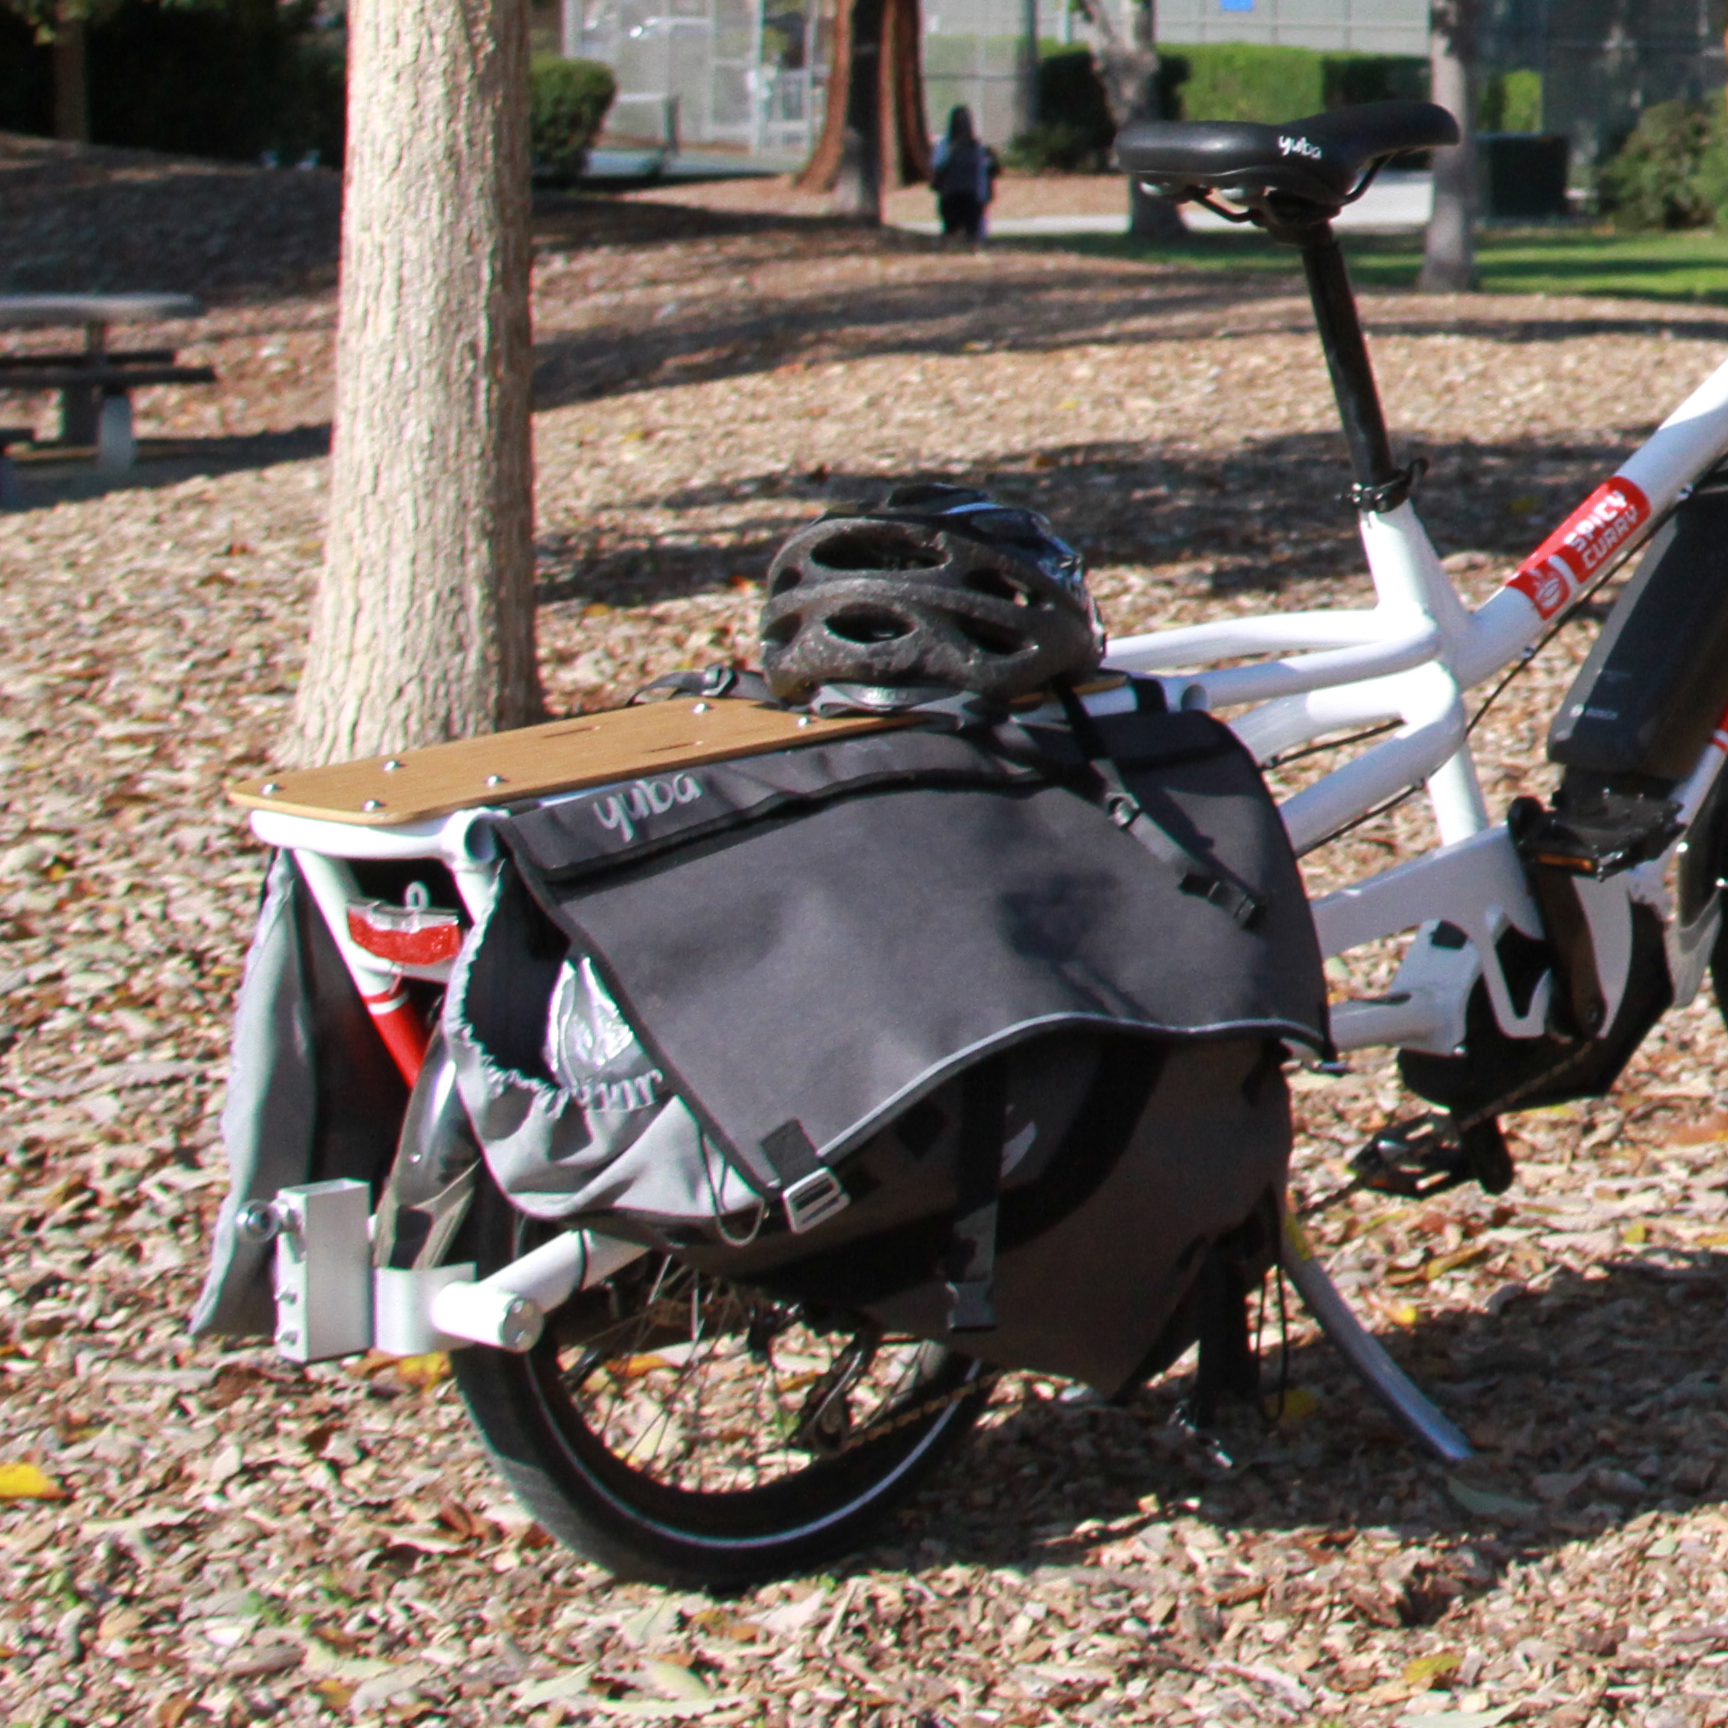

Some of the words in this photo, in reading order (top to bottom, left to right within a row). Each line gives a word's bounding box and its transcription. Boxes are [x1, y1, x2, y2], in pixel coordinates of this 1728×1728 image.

[1279, 135, 1322, 159] yuba
[1564, 490, 1628, 552] SPICY
[1582, 505, 1639, 569] CURRY
[593, 773, 703, 843] yuba
